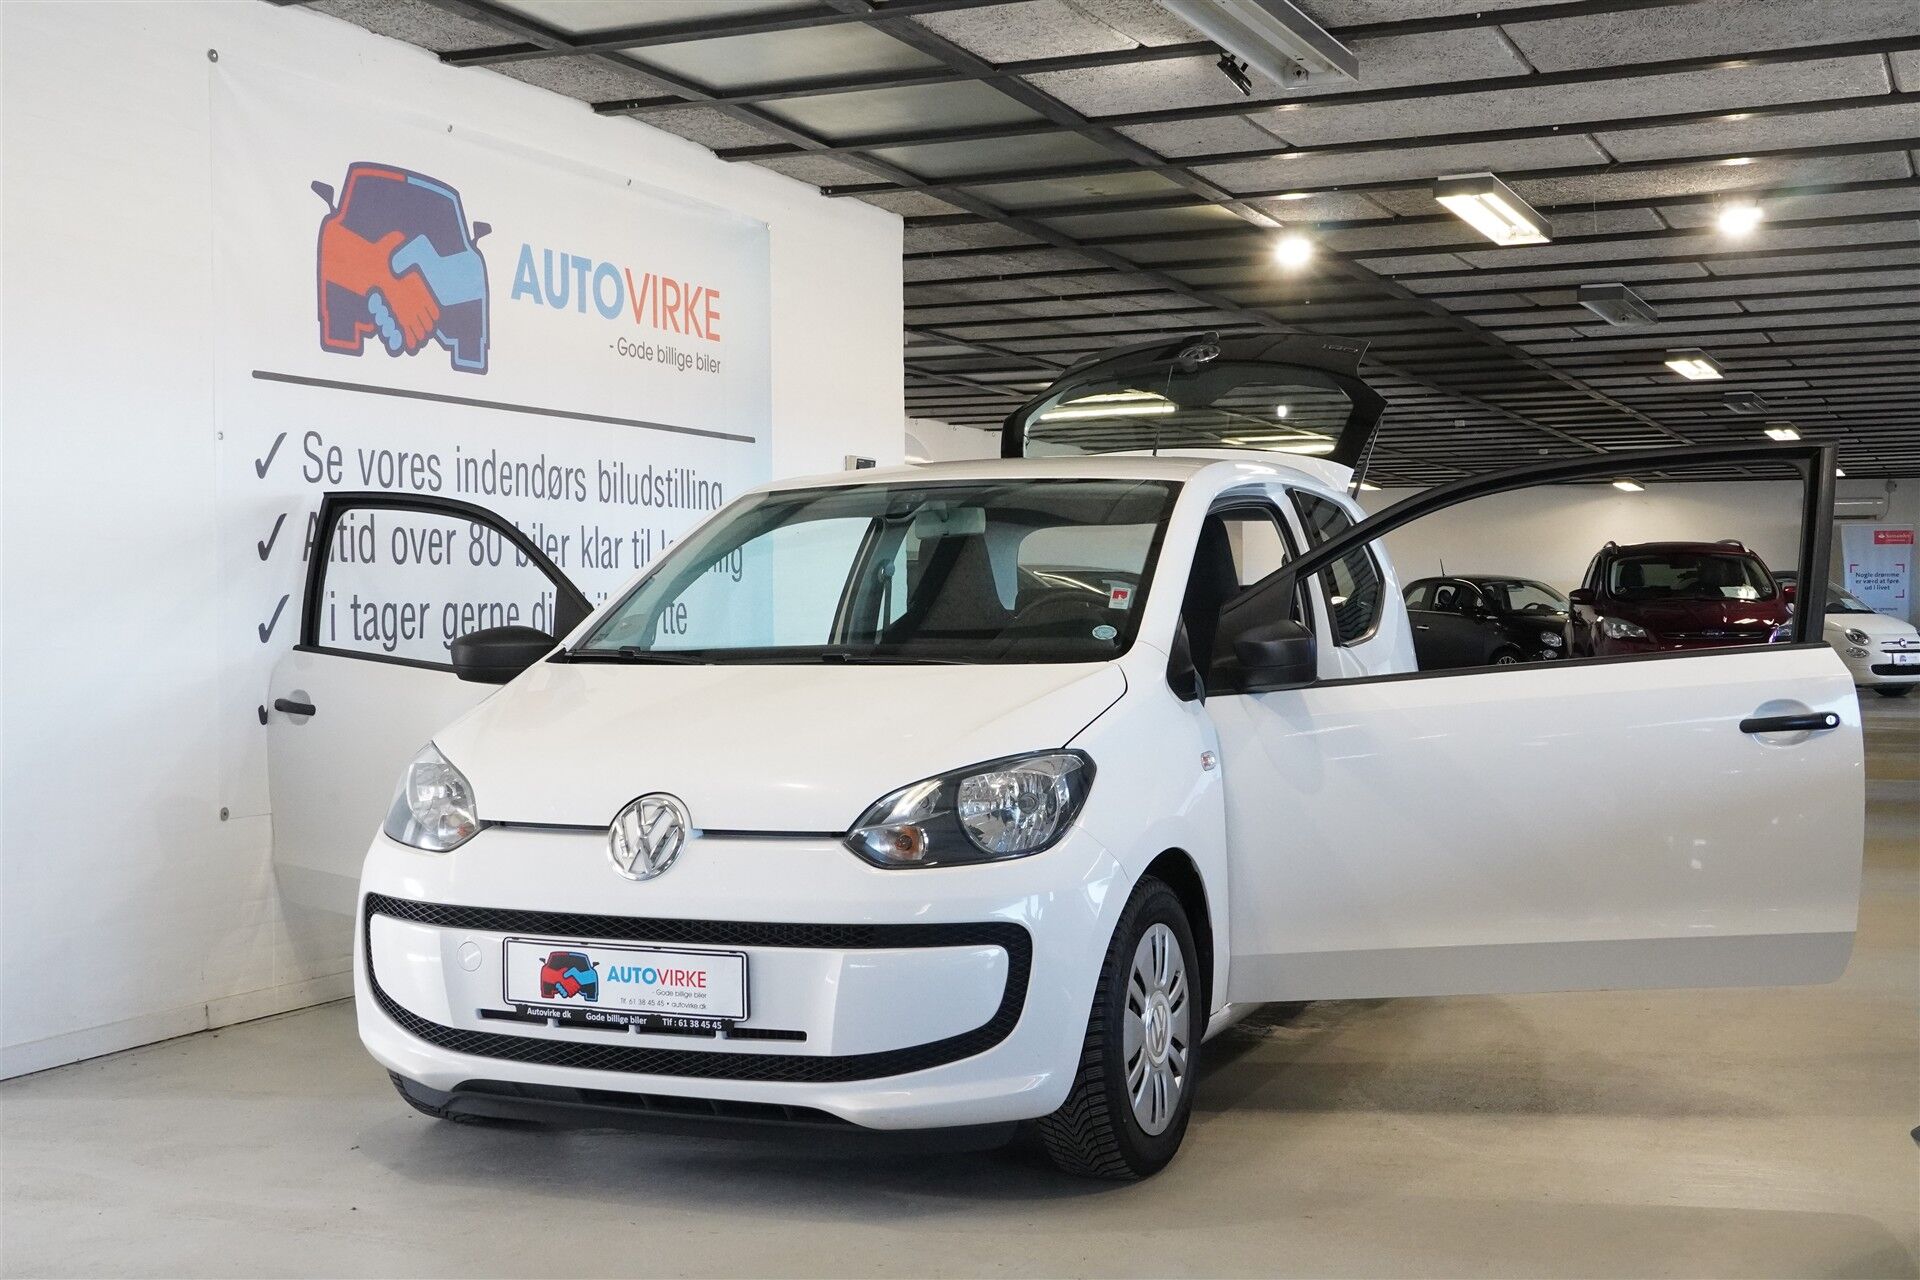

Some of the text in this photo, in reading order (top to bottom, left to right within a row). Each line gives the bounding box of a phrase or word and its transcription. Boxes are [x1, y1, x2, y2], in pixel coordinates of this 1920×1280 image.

[511, 243, 720, 342] AUTOVIRKE
[617, 336, 654, 362] Gode
[657, 344, 693, 372] billige
[696, 352, 721, 374] biler
[303, 430, 723, 511] Se vores indendørs biludstilling
[303, 511, 376, 564] Atid
[391, 526, 457, 566] over
[469, 521, 502, 567] 80
[581, 525, 623, 570] klar
[632, 528, 650, 569] til
[350, 594, 430, 652] tager
[607, 965, 706, 988] AUTOVIRKE
[656, 989, 674, 997] Gode
[675, 990, 692, 999] billige
[693, 991, 707, 999] biler
[586, 1012, 605, 1022] Gode
[606, 1014, 628, 1025] billige
[629, 1015, 647, 1025] biler
[678, 1019, 688, 1028] 61
[690, 1019, 699, 1028] 38
[701, 1020, 711, 1029] 45
[712, 1020, 722, 1030] 45
[647, 999, 656, 1007] 45
